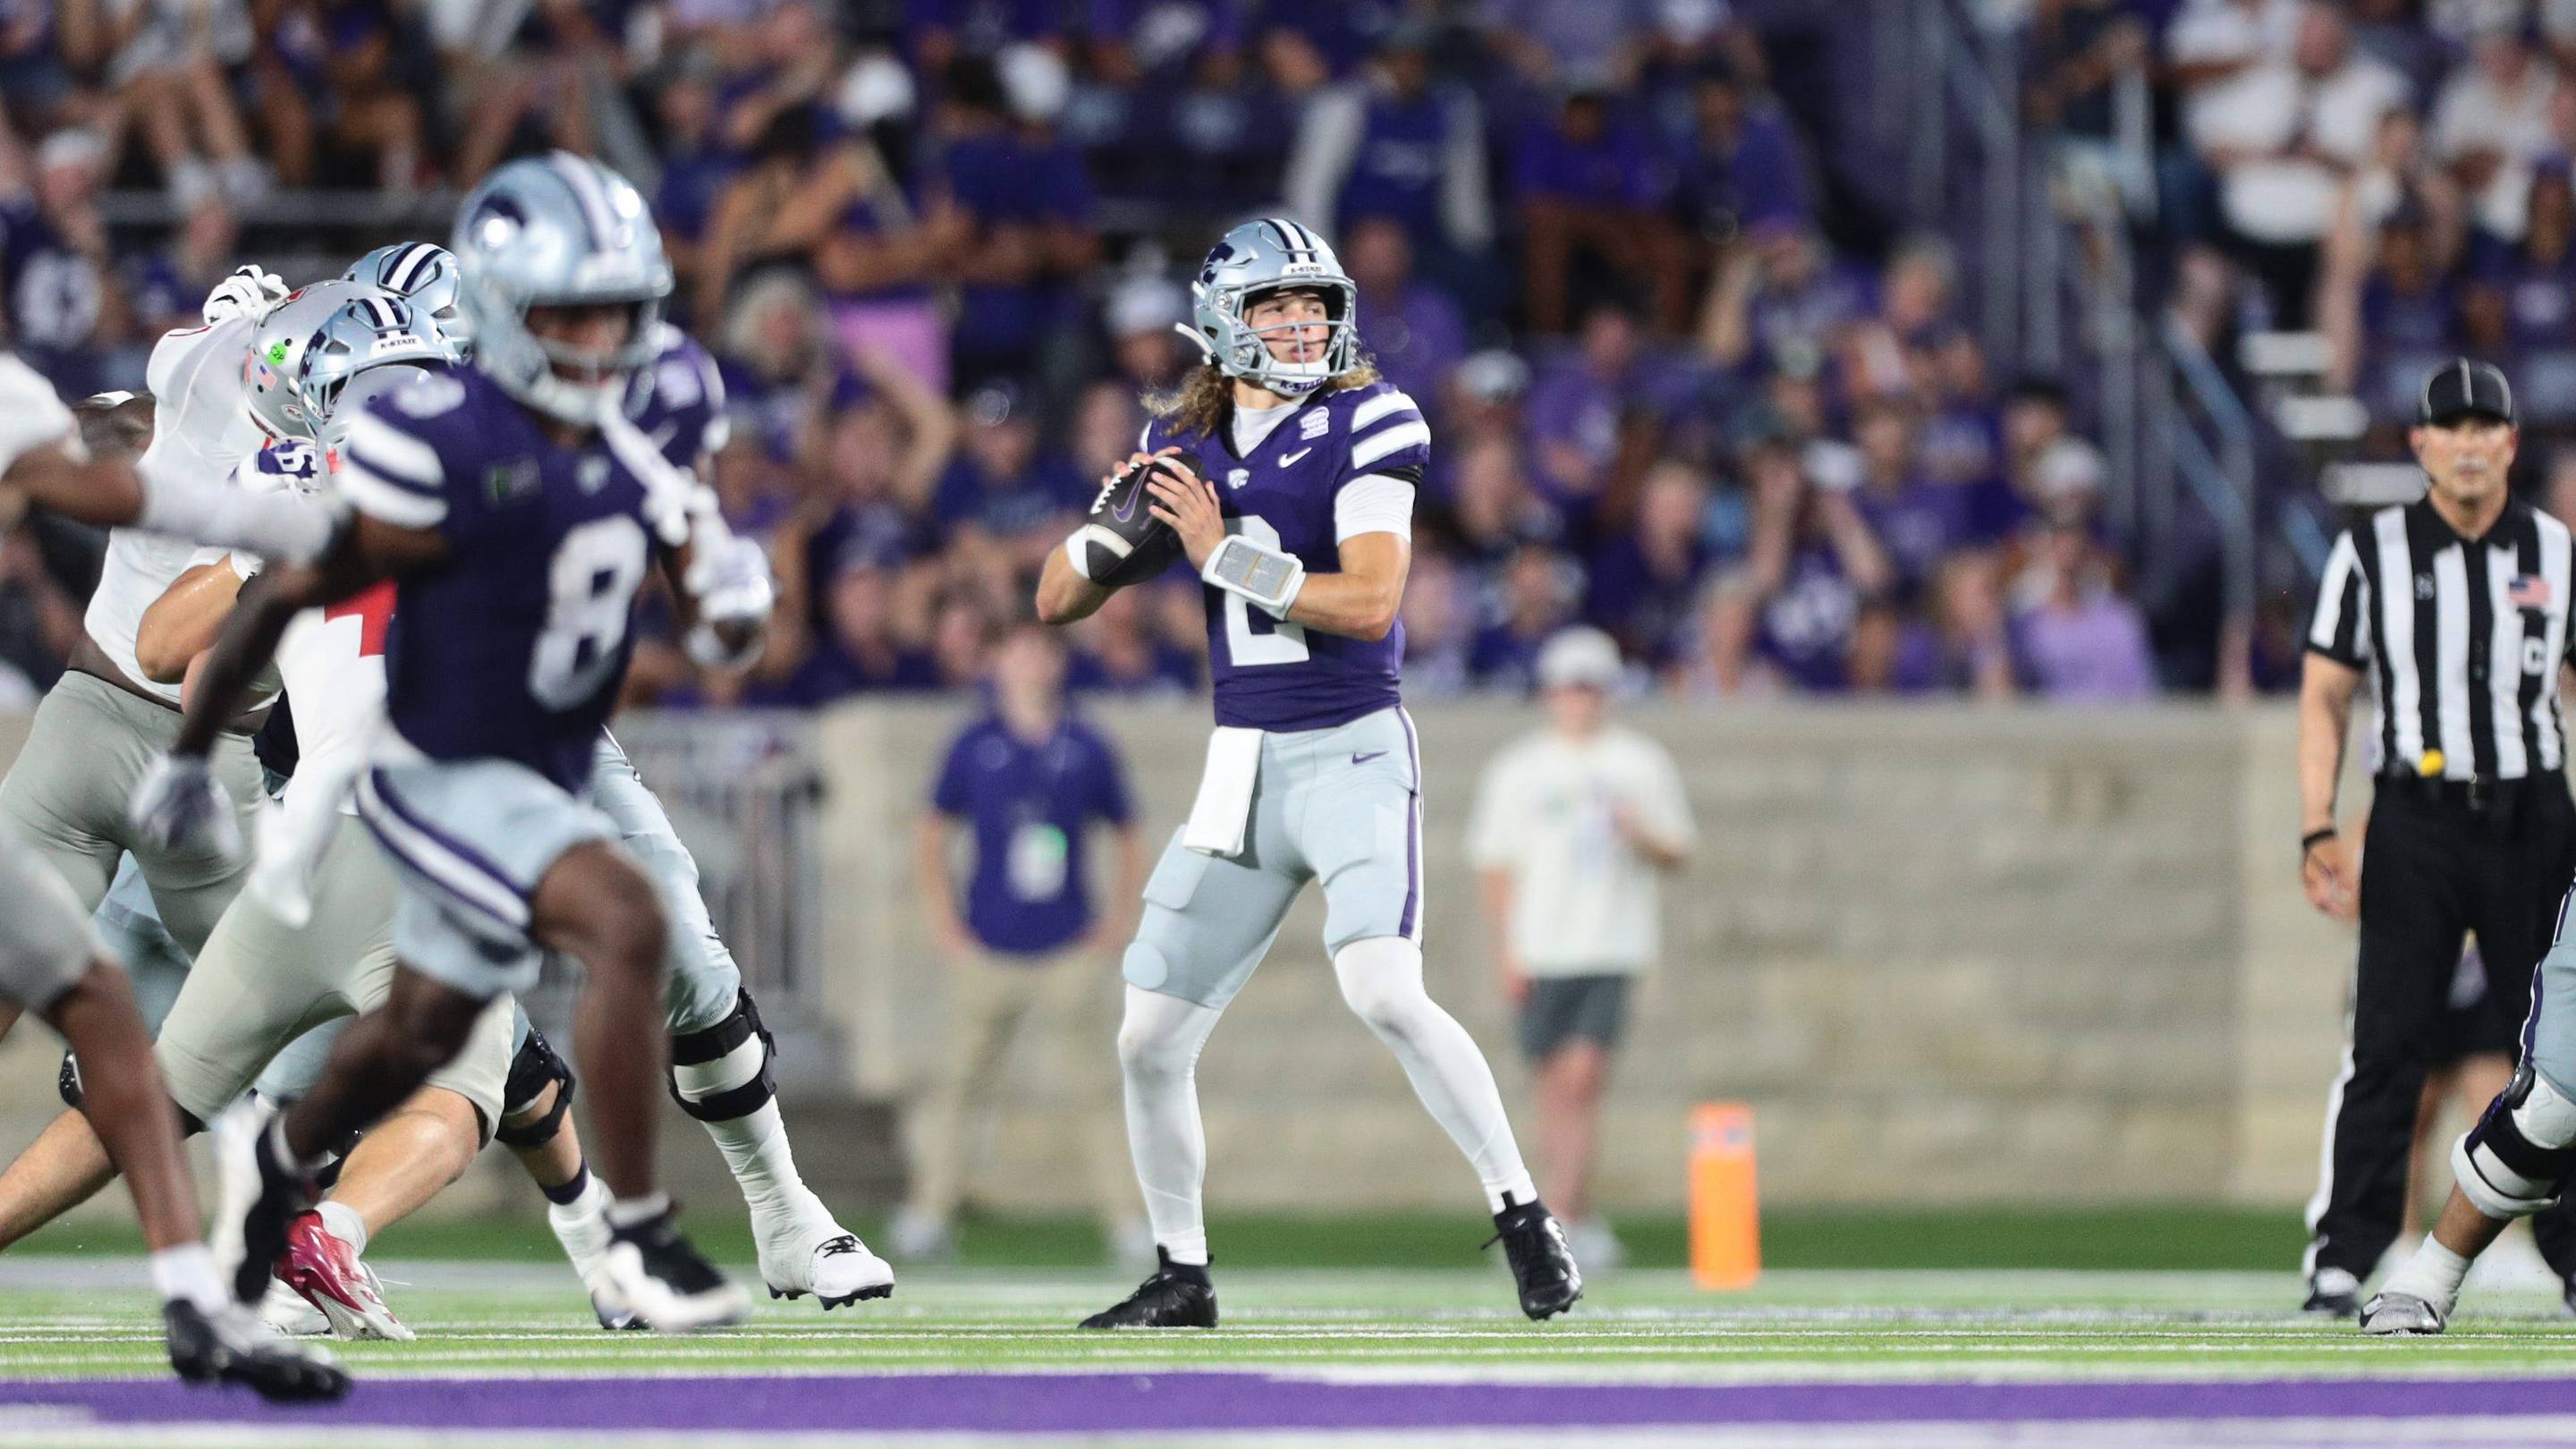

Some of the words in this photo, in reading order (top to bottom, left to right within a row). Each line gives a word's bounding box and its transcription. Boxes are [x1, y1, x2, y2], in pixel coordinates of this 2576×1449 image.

[380, 338, 418, 350] K-STATE
[528, 513, 648, 714] 8
[1224, 514, 1310, 667] 2
[2522, 636, 2547, 676] C
